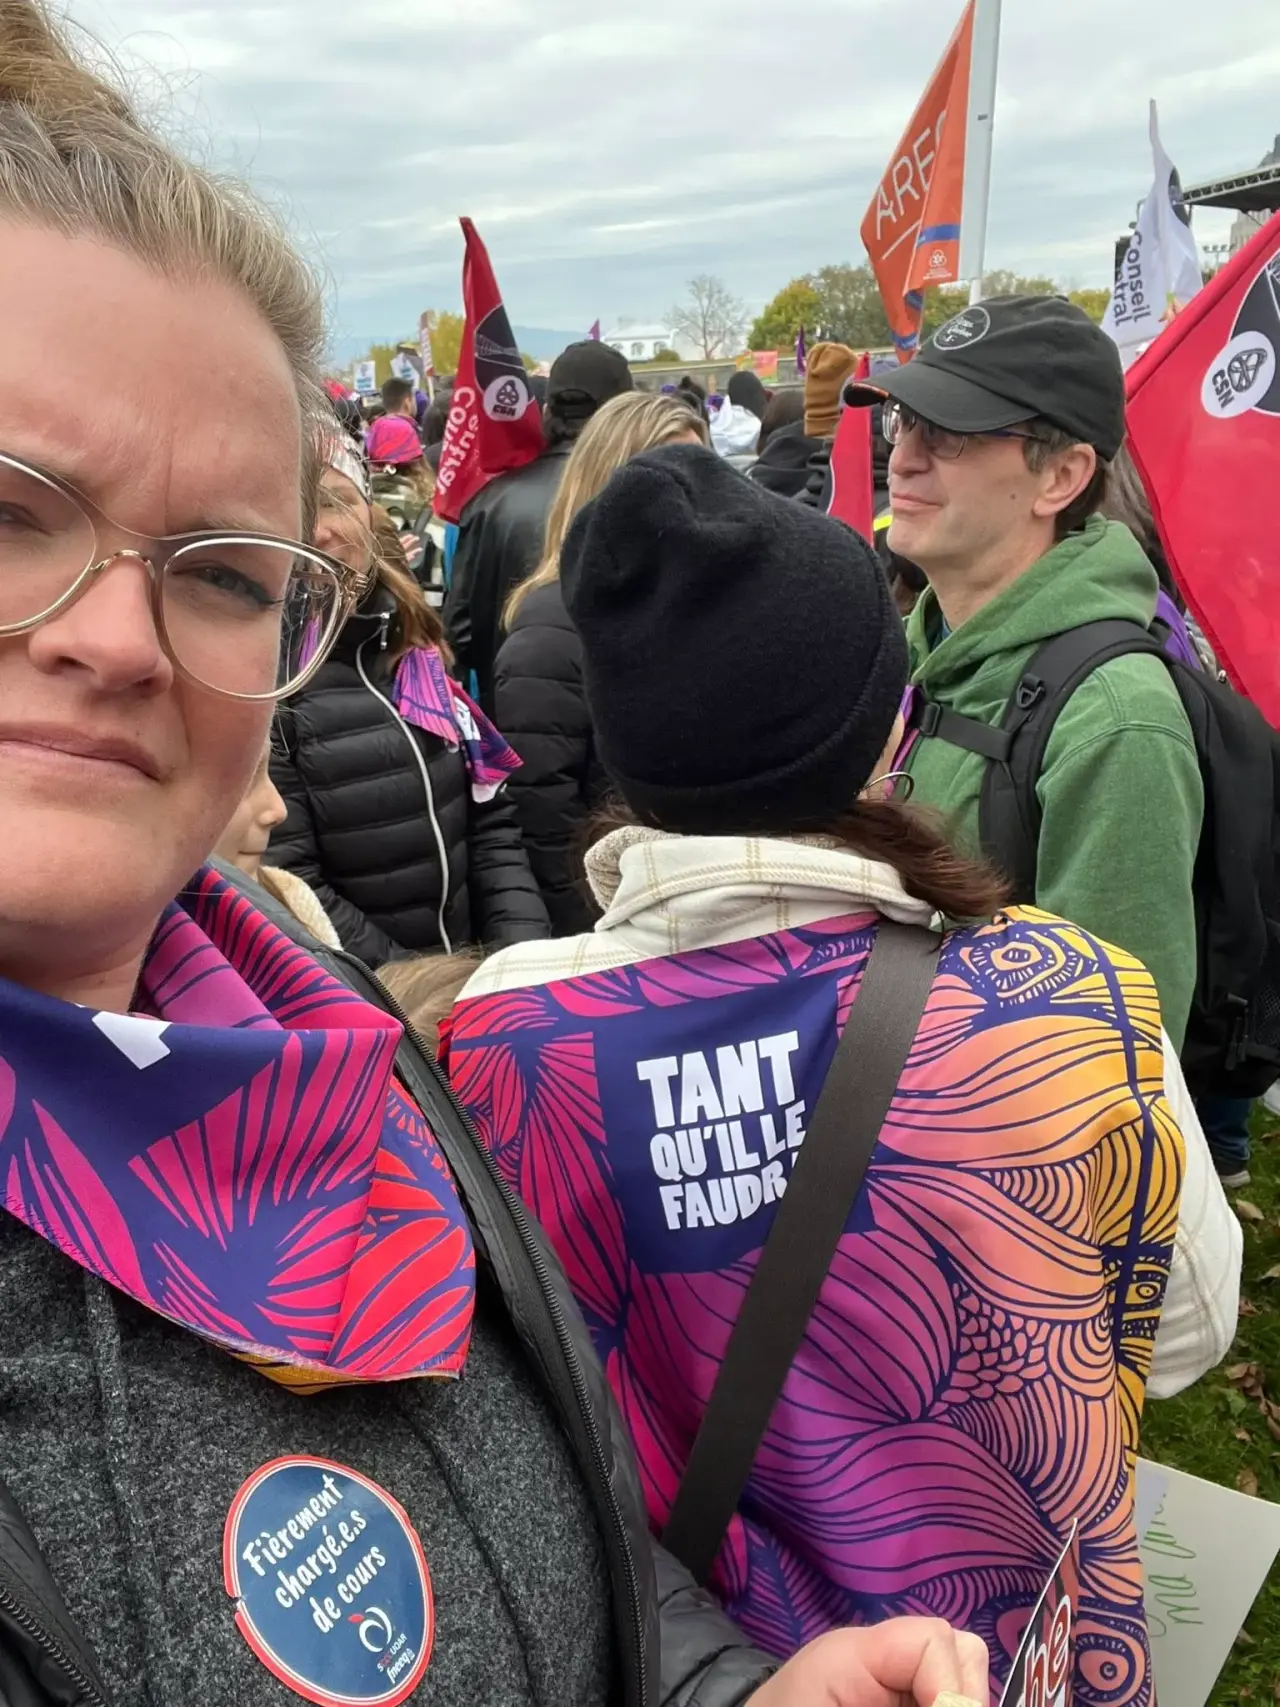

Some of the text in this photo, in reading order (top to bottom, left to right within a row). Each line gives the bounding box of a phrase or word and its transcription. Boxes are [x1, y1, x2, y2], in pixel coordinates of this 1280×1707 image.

[1212, 369, 1235, 410] CSN
[636, 1030, 799, 1129] TANT
[649, 1099, 807, 1182] QU'IL LE
[659, 1151, 799, 1231] FAUDR
[242, 1473, 344, 1577] Fièrement
[274, 1509, 367, 1609] chargé.e.s
[308, 1546, 387, 1634] de cours
